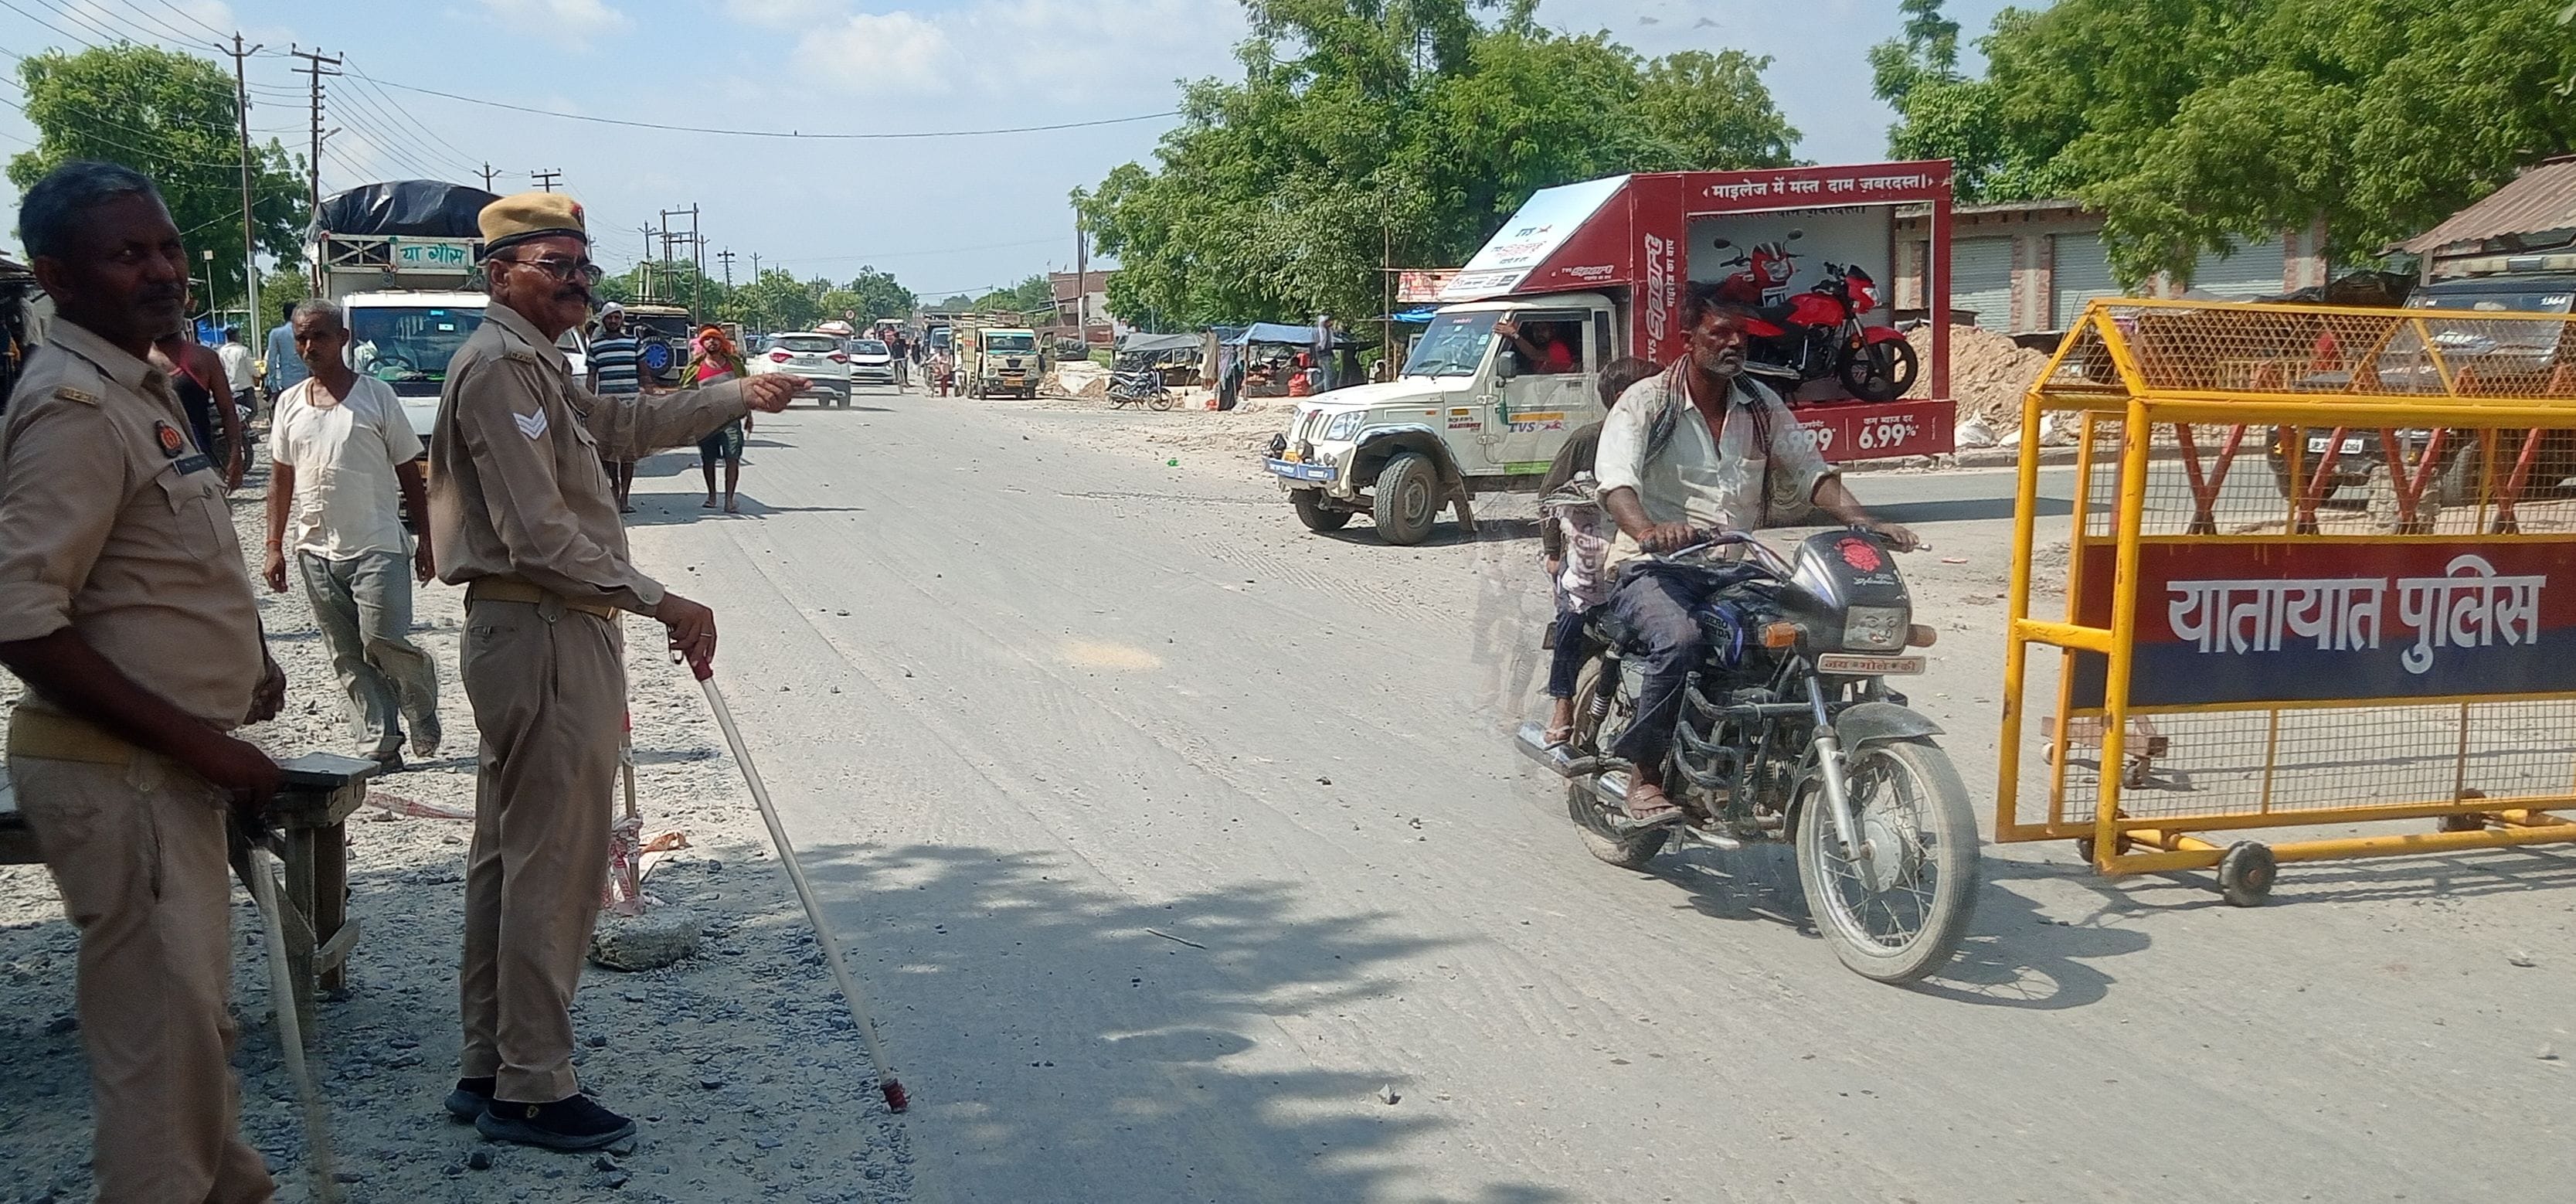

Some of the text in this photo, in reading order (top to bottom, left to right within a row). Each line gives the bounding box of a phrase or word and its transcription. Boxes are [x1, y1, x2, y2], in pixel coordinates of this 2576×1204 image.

[1711, 179, 1768, 201] माइलेज
[1772, 177, 1785, 194] में
[1789, 180, 1819, 194] मस्त
[1827, 179, 1854, 193] दाम
[399, 247, 423, 261] या
[1644, 232, 1667, 342] Sport
[1508, 422, 1536, 433] TVS
[2166, 554, 2547, 674] यातायात पुलिस
[1825, 660, 1849, 668] जय
[1901, 660, 1916, 670] की
